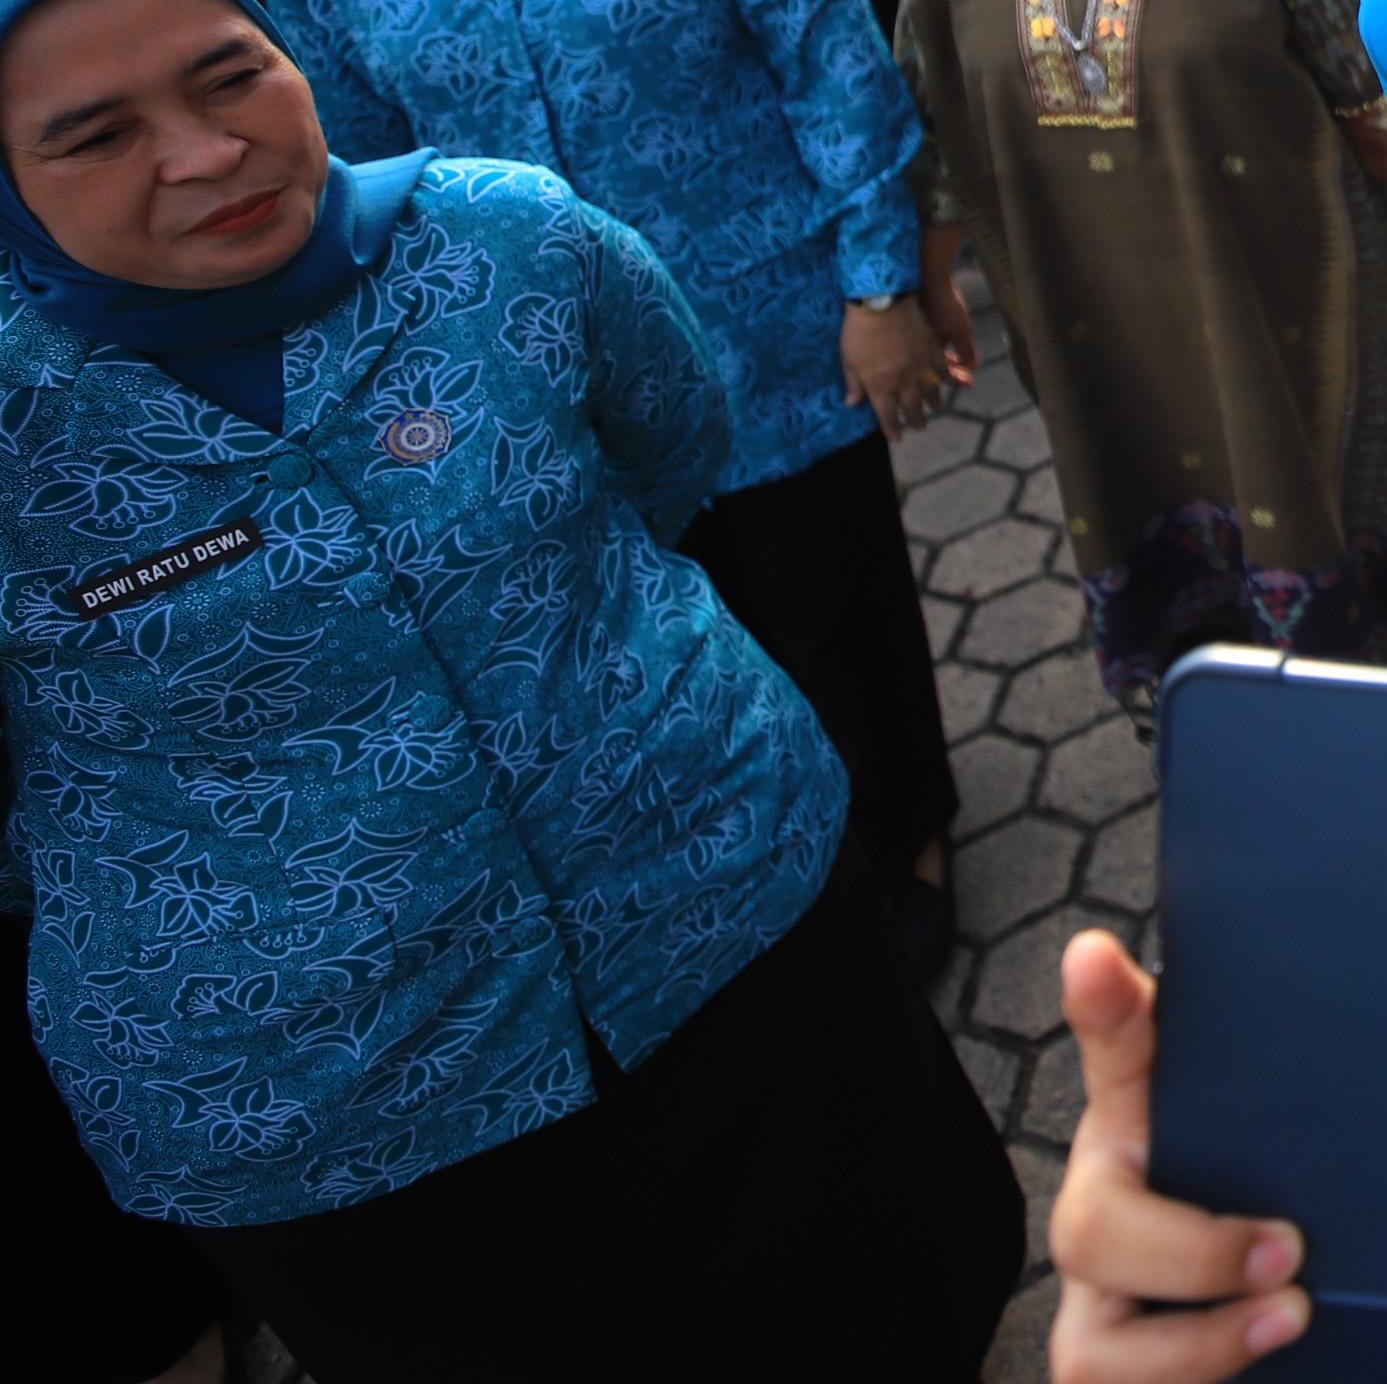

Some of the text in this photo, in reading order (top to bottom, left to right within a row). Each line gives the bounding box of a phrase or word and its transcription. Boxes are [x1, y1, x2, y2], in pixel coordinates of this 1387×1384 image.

[81, 528, 250, 609] DEWI RATU DEWA
